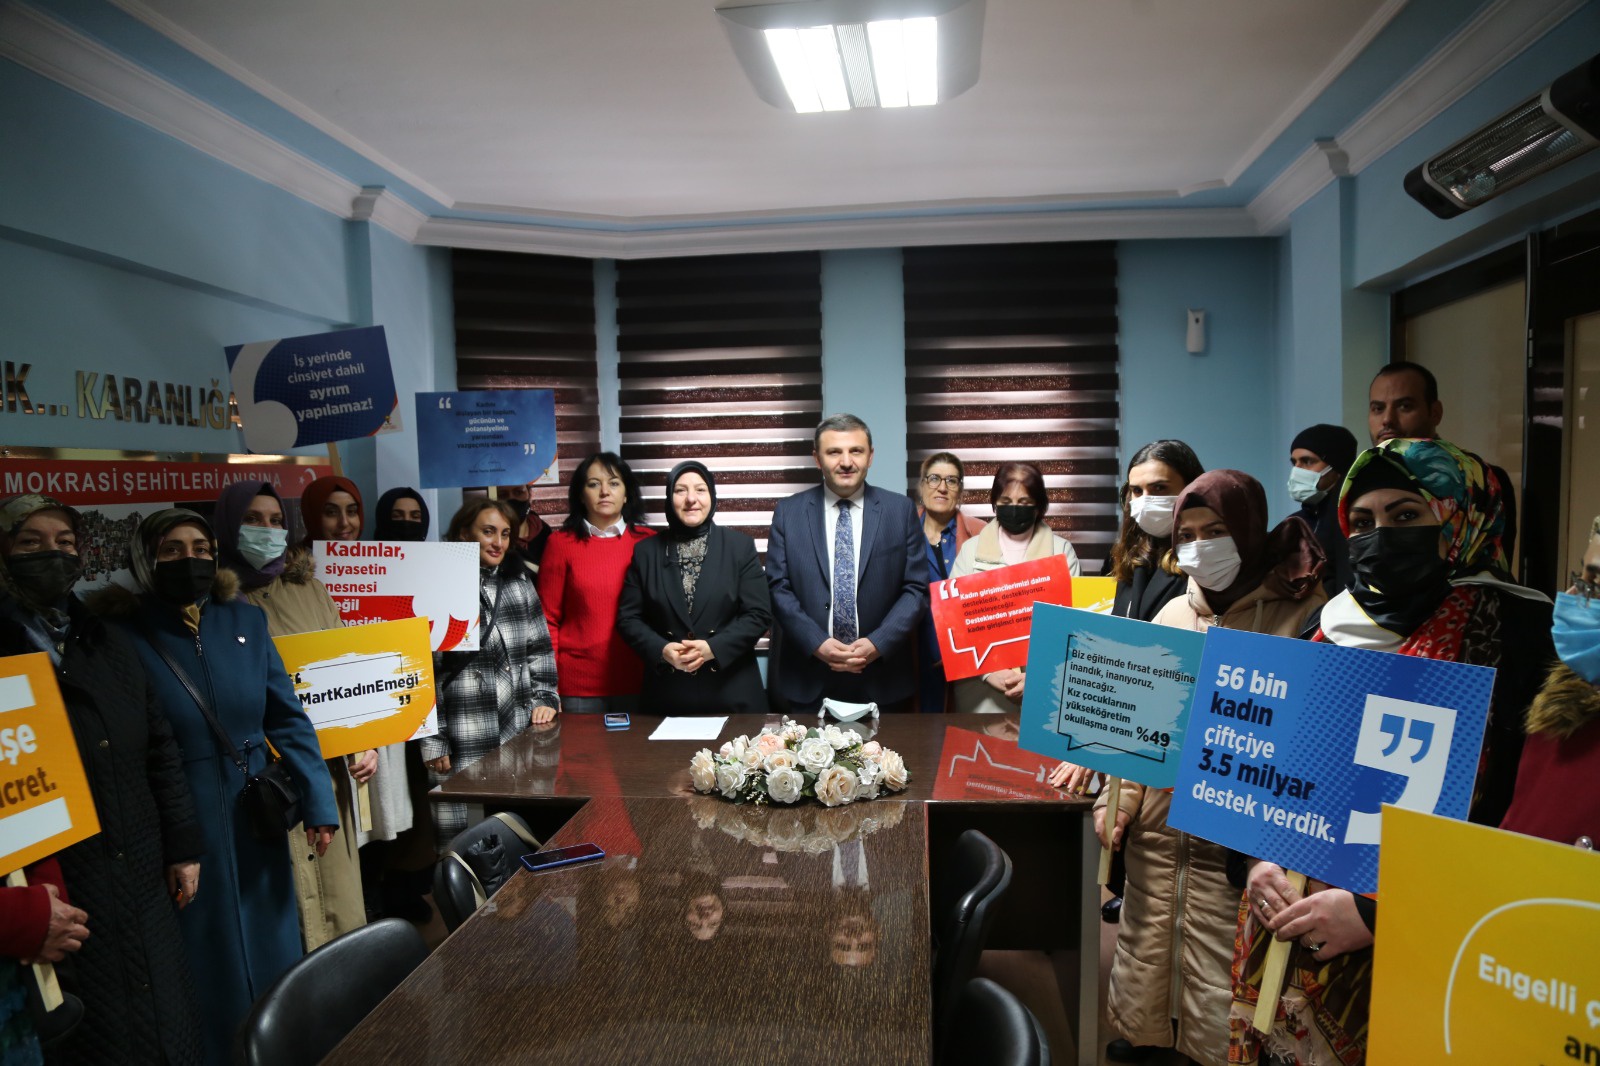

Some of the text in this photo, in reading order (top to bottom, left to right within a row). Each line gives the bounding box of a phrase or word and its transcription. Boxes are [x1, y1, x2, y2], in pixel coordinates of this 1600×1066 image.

[294, 349, 352, 367] İş yerinde
[287, 363, 365, 384] cinsiyet dahil
[0, 360, 243, 432] K... KARANLIĞA
[309, 384, 350, 400] ayrım
[296, 398, 374, 422] yapılamaz!
[0, 468, 118, 493] MOKRASİ
[123, 468, 219, 495] ŞEHİTLERİ
[326, 541, 405, 560] Kadınlar,
[325, 564, 387, 576] siyasetin
[326, 582, 377, 593] nesnesi
[959, 591, 979, 601] Kadın
[1030, 576, 1051, 585] daima
[335, 599, 360, 613] eğil
[967, 624, 986, 633] kadın
[986, 619, 1015, 631] girişimci
[1070, 662, 1155, 690] inandık, inanıyoruz,
[1071, 649, 1196, 684] Biz eğitimde fırsat eşitliğine
[1068, 674, 1117, 694] inanacağız.
[1215, 664, 1288, 700] 56 bin
[1066, 701, 1131, 724] yükseköğretim
[1067, 687, 1136, 712] Kız çocuklarının
[1210, 691, 1273, 727] kadın
[1064, 713, 1171, 747] okullaşma oranı %49
[1204, 724, 1275, 759] çiftçiye
[0, 724, 38, 766] şe
[1197, 747, 1316, 801] 3.5 milyar
[0, 767, 57, 808] cret.
[1192, 780, 1335, 844] destek verdik.
[1478, 953, 1577, 1015] Engelli
